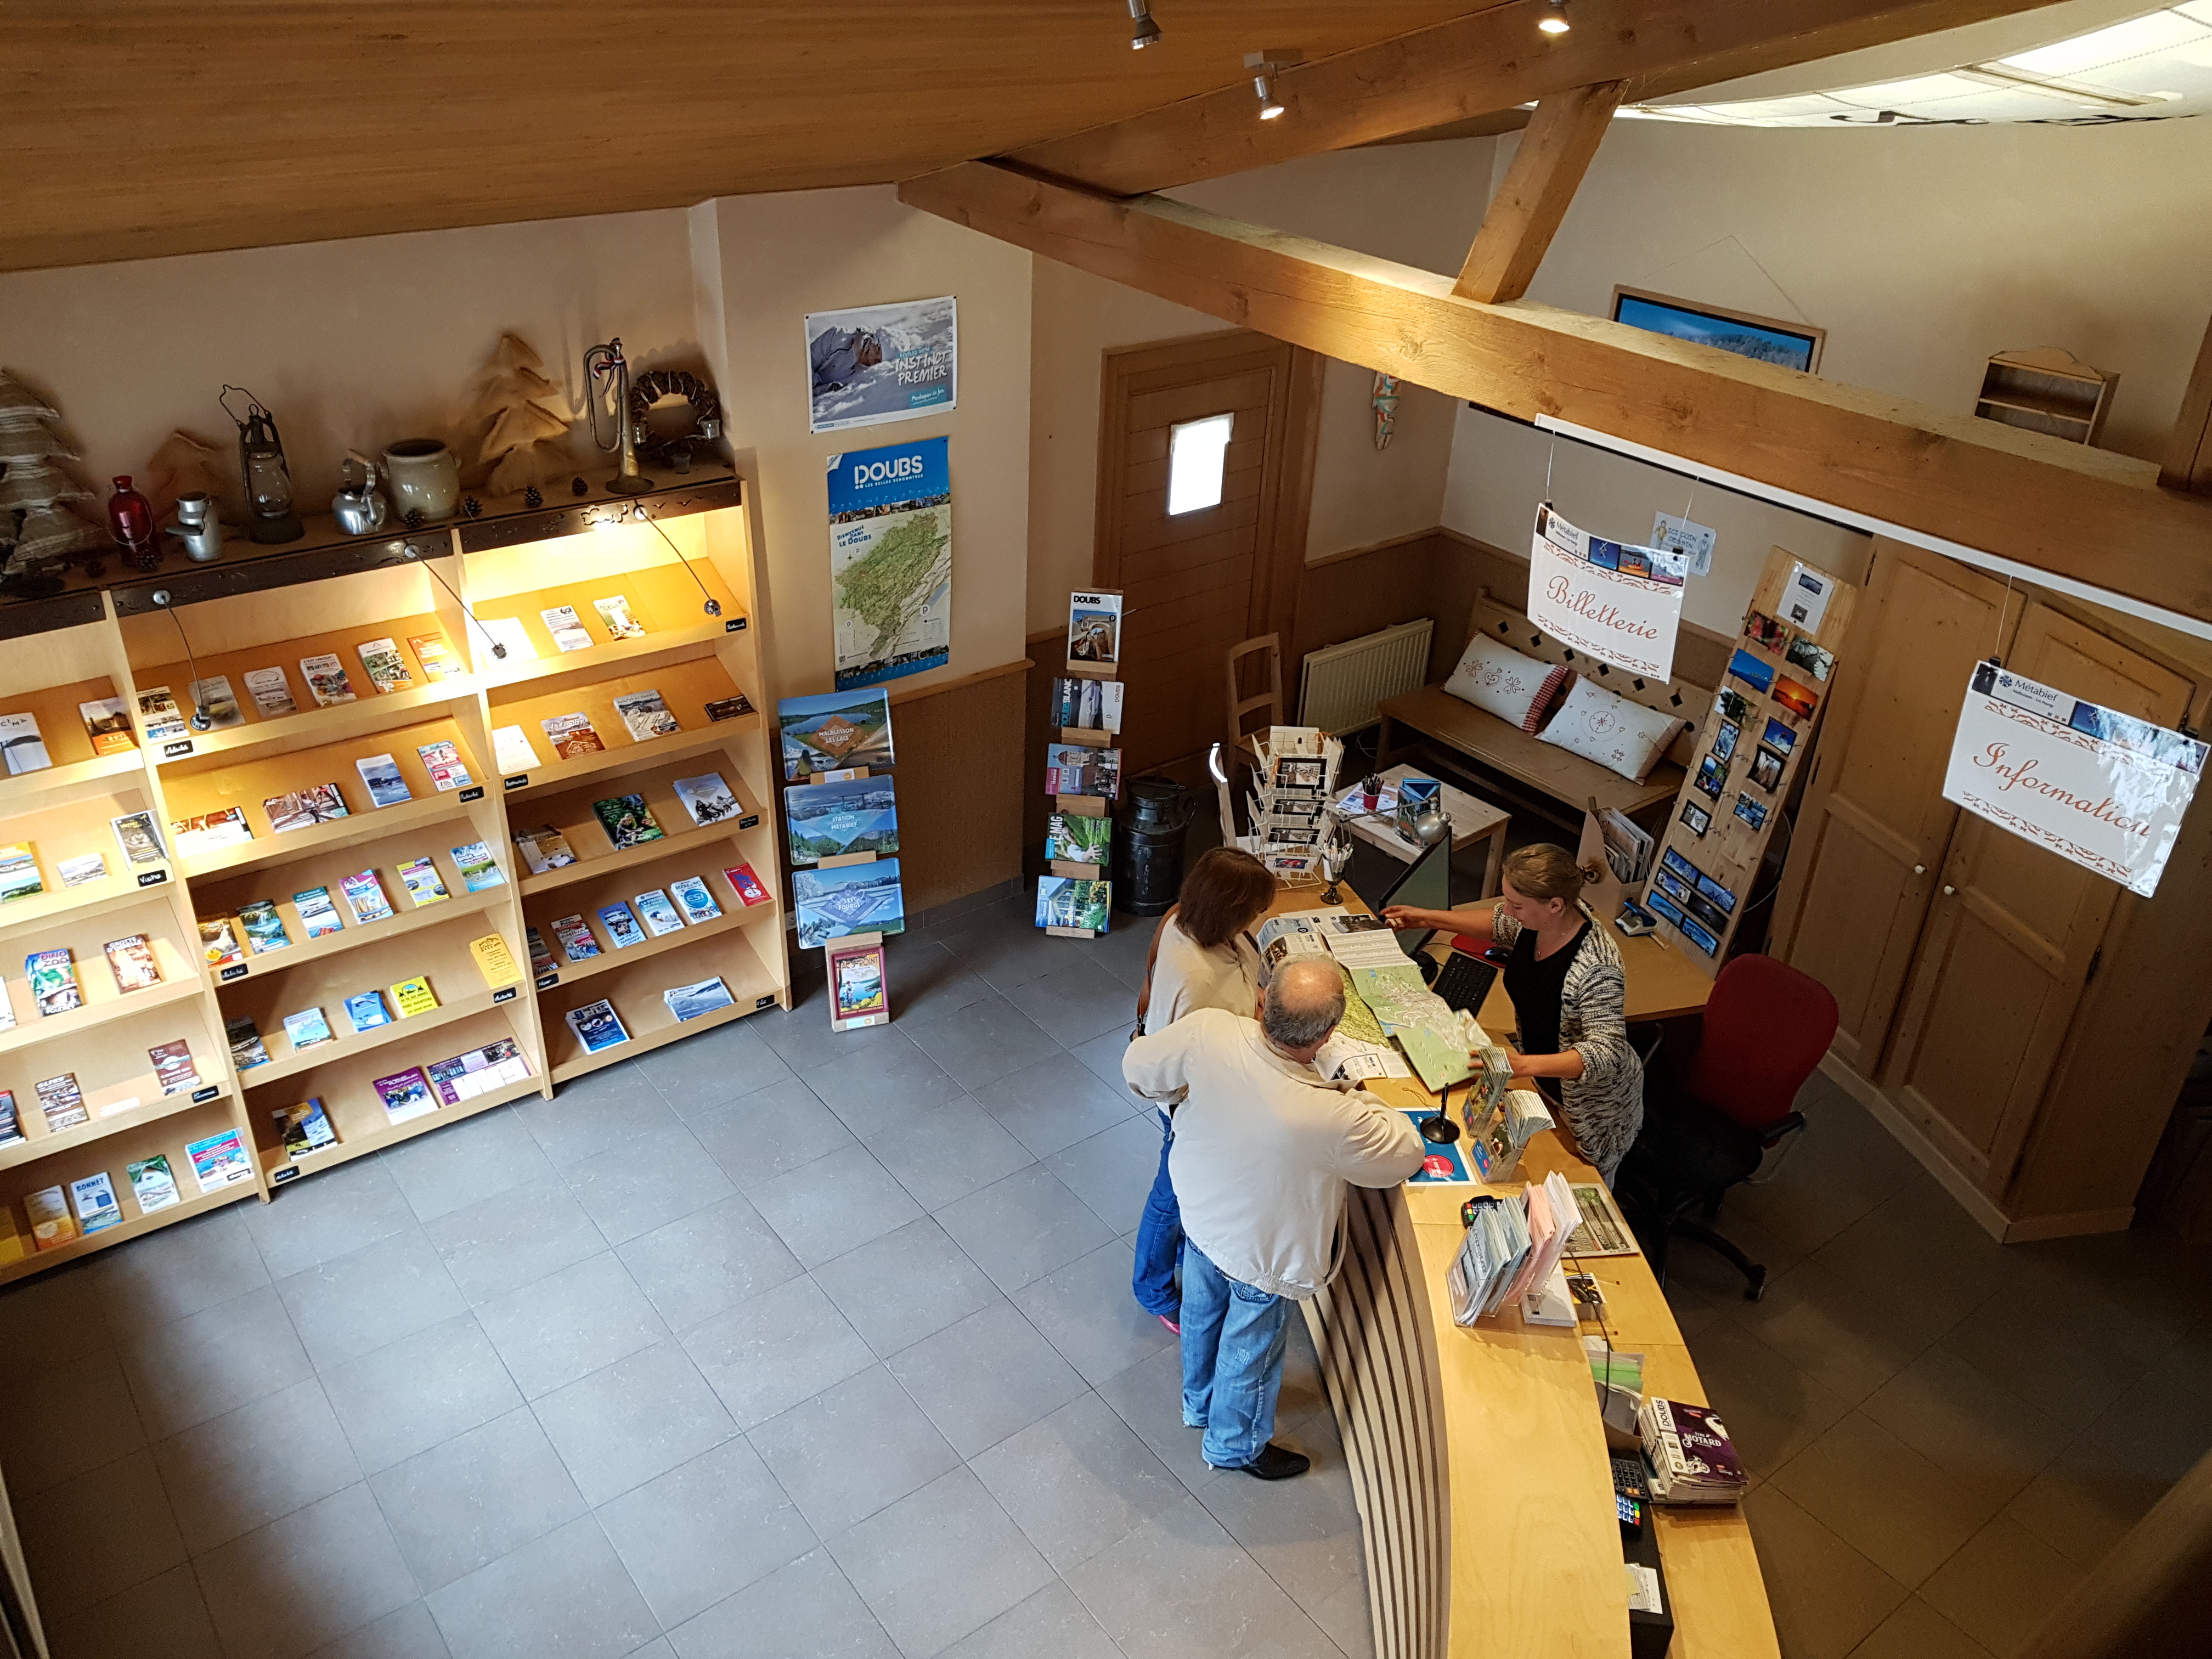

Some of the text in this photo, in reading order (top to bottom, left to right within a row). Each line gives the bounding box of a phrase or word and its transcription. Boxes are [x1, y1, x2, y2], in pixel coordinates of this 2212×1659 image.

[895, 349, 952, 372] INSTINCT
[898, 365, 948, 386] PREMIER
[854, 455, 923, 485] DOUBS
[837, 524, 865, 540] BIENVENUE
[850, 531, 864, 539] DANS
[1556, 521, 1579, 540] Métabief
[1668, 527, 1697, 543] ICI COIN
[848, 534, 872, 545] DOUBS
[1669, 536, 1694, 549] DESSIN
[1074, 595, 1101, 605] DOUBS
[1547, 575, 1658, 639] Billetterie
[2015, 679, 2059, 702] Métabief
[819, 727, 854, 737] MALBUISSON
[1973, 742, 2151, 837] Information
[831, 821, 858, 830] MÉTABIEF
[832, 814, 855, 822] STATION
[1049, 816, 1063, 834] MAG
[687, 893, 704, 901] ESI
[838, 902, 860, 911] FOURGS
[110, 936, 138, 948] GROTTE
[40, 951, 67, 961] DINO
[43, 957, 69, 966] ZOO
[76, 1177, 104, 1192] BONNET
[1661, 1399, 1672, 1427] DOUBS
[1681, 1433, 1722, 1448] MOTARD
